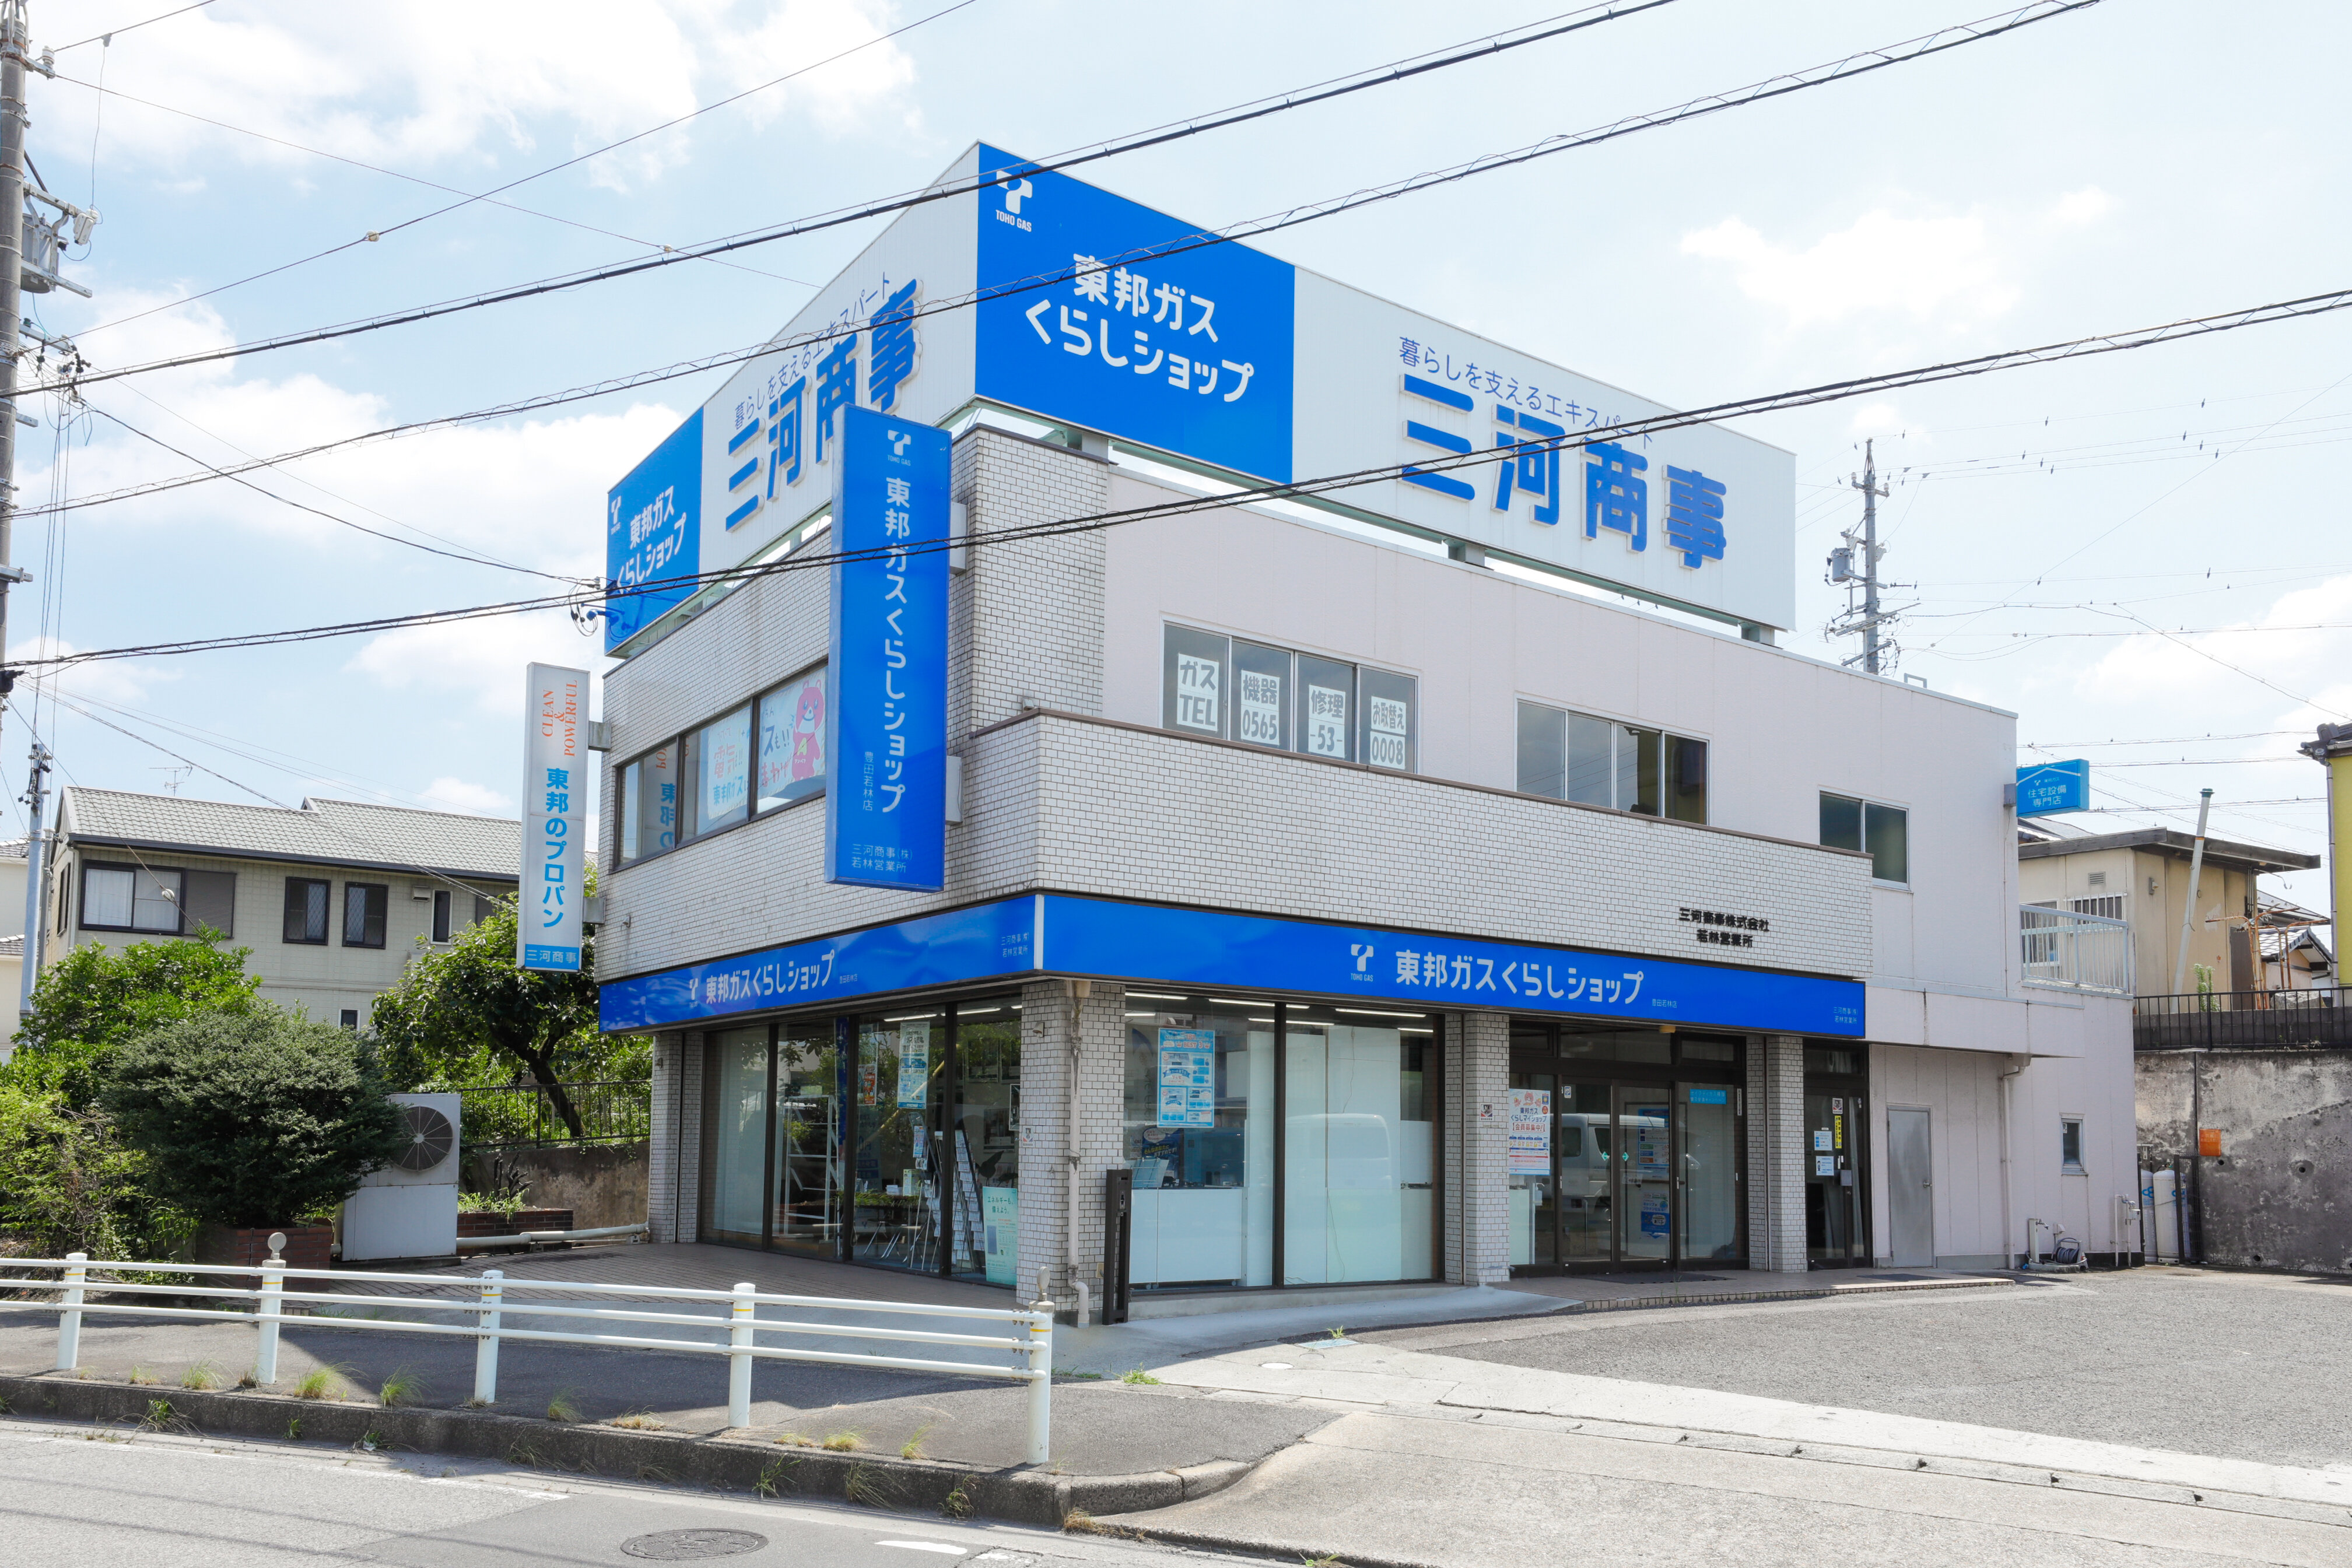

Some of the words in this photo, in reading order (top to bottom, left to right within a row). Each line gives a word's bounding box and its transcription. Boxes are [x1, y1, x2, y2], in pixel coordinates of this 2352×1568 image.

[996, 209, 1016, 226] TOHO
[1016, 218, 1032, 233] GAS
[1073, 253, 1219, 343] 東邦ガス
[735, 272, 890, 430] 暮らしを支えるエキスパート
[1025, 299, 1254, 402] くらしショップ
[725, 278, 924, 533] 三河商事
[1400, 336, 1653, 450] 暮らしを支えるエキスパート
[887, 454, 899, 464] TOHO
[901, 458, 912, 466] GAS
[1398, 373, 1727, 570] 三河商事
[630, 485, 674, 550] 東邦ガス
[617, 511, 686, 595] くらしショップ
[879, 476, 912, 813] 東邦ガスくらしショップ
[542, 689, 555, 737] CLEAN
[554, 711, 565, 722] &
[564, 680, 577, 757] POWERFUL
[1180, 660, 1217, 691] ガス
[1243, 674, 1278, 706] 機器
[1312, 689, 1344, 720] 修理
[1372, 701, 1405, 731] お取替え
[1179, 693, 1216, 727] TEL
[1242, 709, 1277, 741] 0565
[1372, 735, 1405, 766] 0008
[863, 751, 875, 812] 豊田若林店
[2028, 784, 2067, 798] 住宅設備
[2032, 796, 2062, 808] 専門店
[542, 767, 569, 928] 東邦のプロパン
[851, 857, 907, 874] 若林営業所
[1679, 907, 1770, 932] 三河商事株式会社
[1696, 929, 1754, 948] 若林営業所
[526, 949, 577, 964] 三河商事
[706, 949, 835, 1005] 東邦ガスくらしショップ
[1351, 973, 1363, 981] TOHO
[1363, 974, 1373, 982] GAS
[1396, 949, 1644, 1004] 東邦ガスくらしショップ
